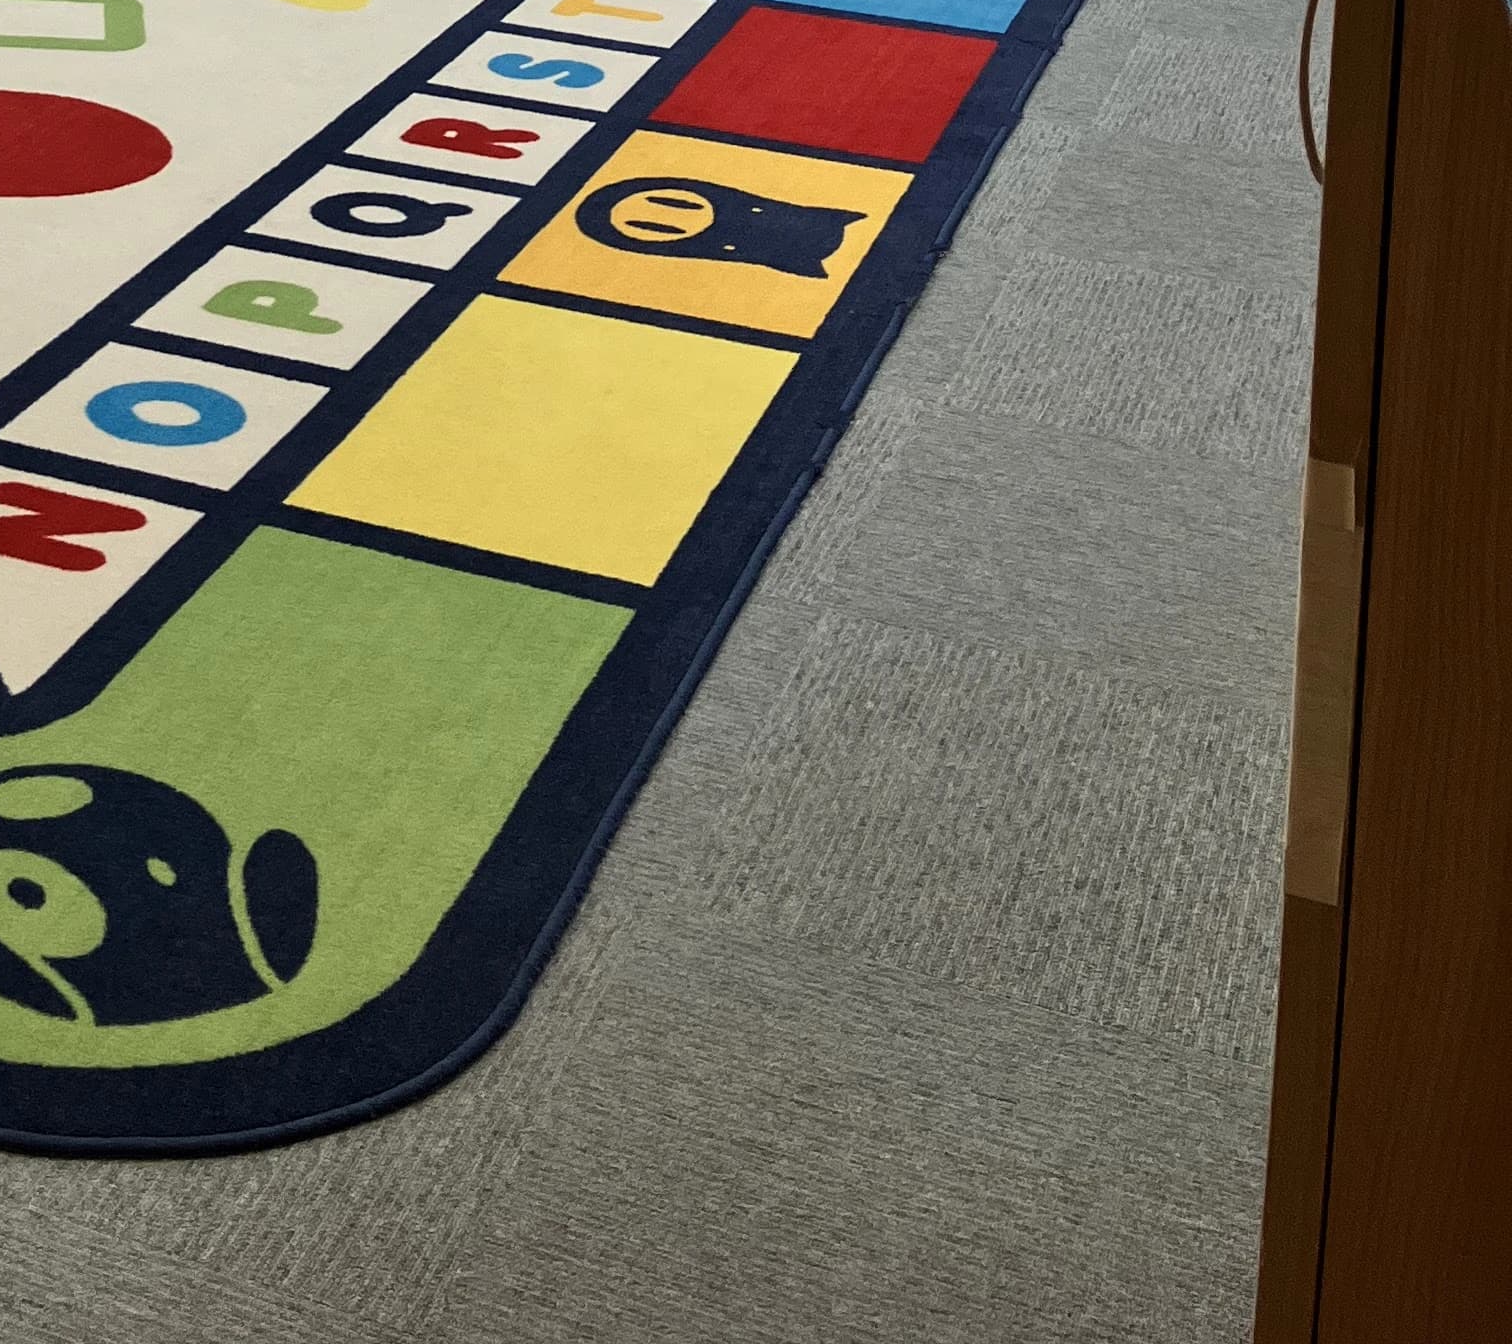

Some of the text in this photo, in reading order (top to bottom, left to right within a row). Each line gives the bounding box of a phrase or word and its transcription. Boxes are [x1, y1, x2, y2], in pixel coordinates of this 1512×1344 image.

[487, 52, 606, 89] S
[400, 117, 541, 160] R
[310, 191, 474, 239] Q
[201, 279, 344, 336] P
[85, 380, 248, 448] O
